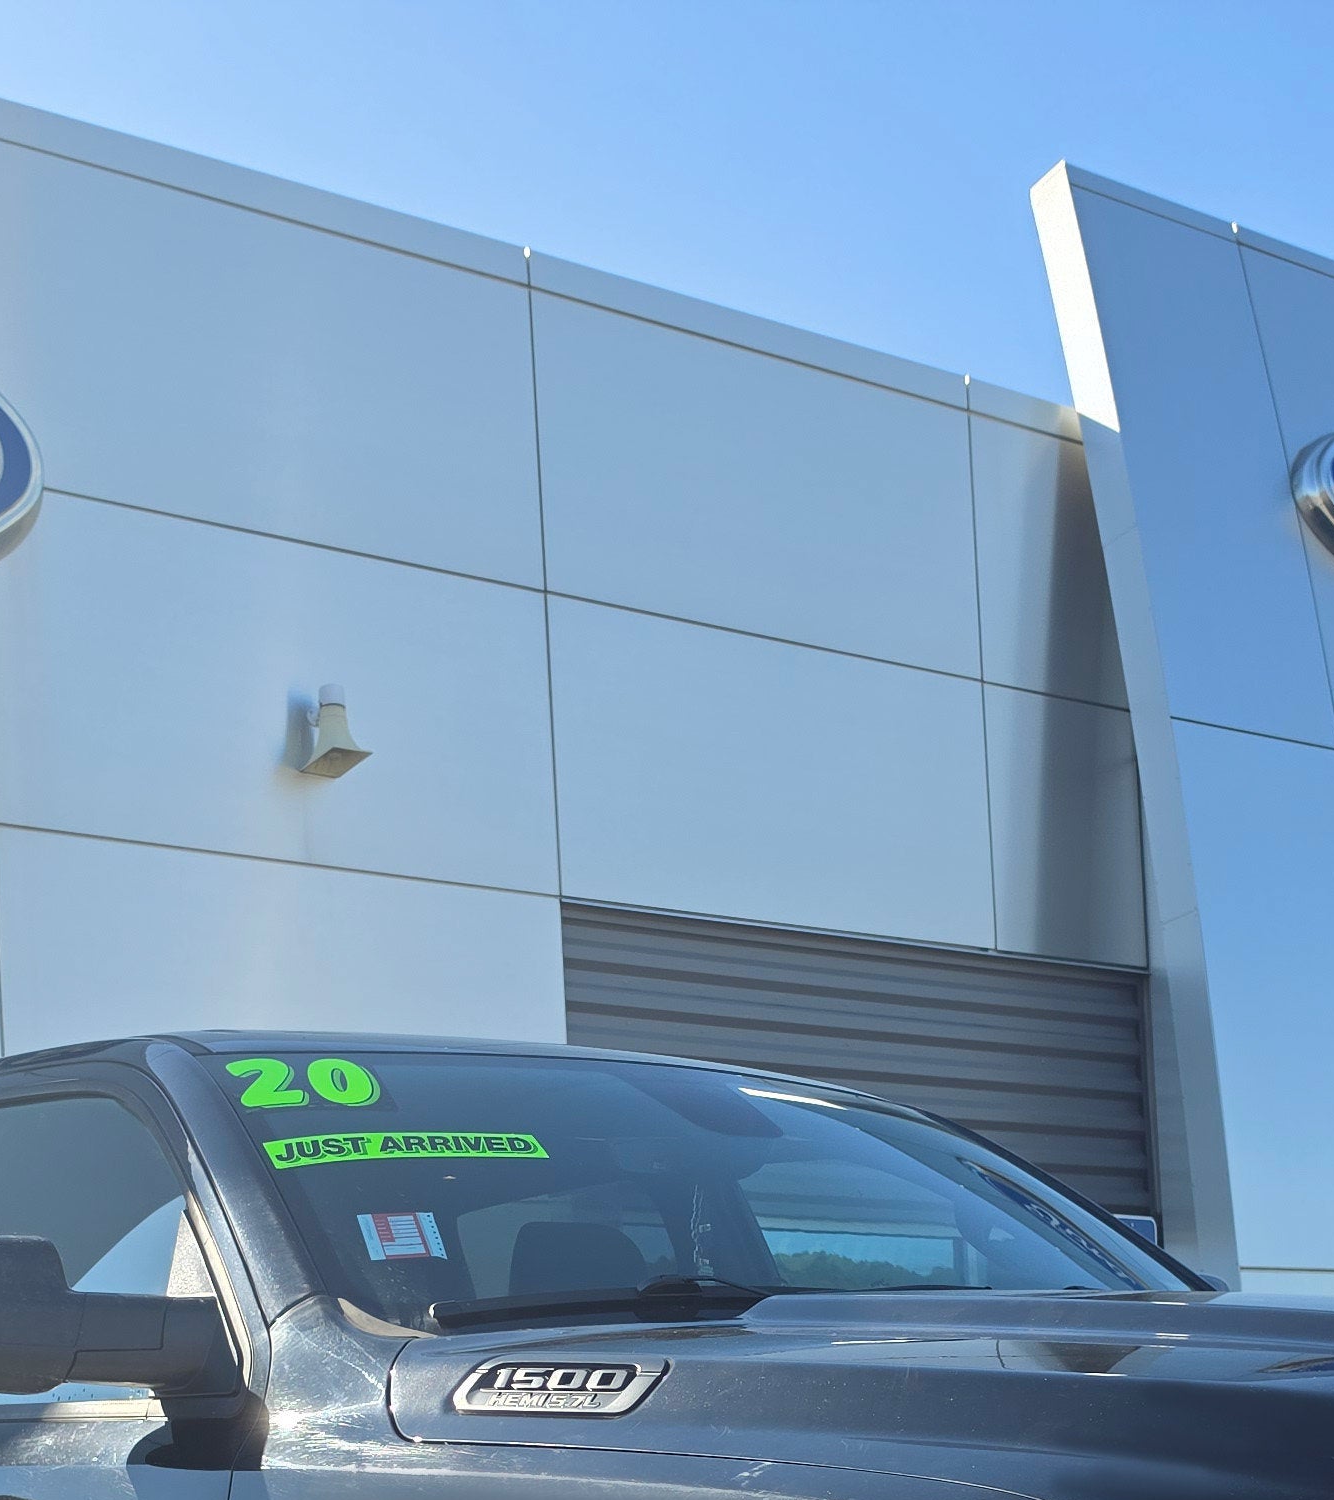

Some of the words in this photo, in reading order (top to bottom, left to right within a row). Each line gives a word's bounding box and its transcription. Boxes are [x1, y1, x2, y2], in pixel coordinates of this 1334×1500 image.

[225, 1058, 381, 1107] 20
[275, 1136, 370, 1163] JUST
[379, 1133, 537, 1156] ARRIVED
[494, 1367, 628, 1391] 1500
[487, 1392, 545, 1409] HEMI
